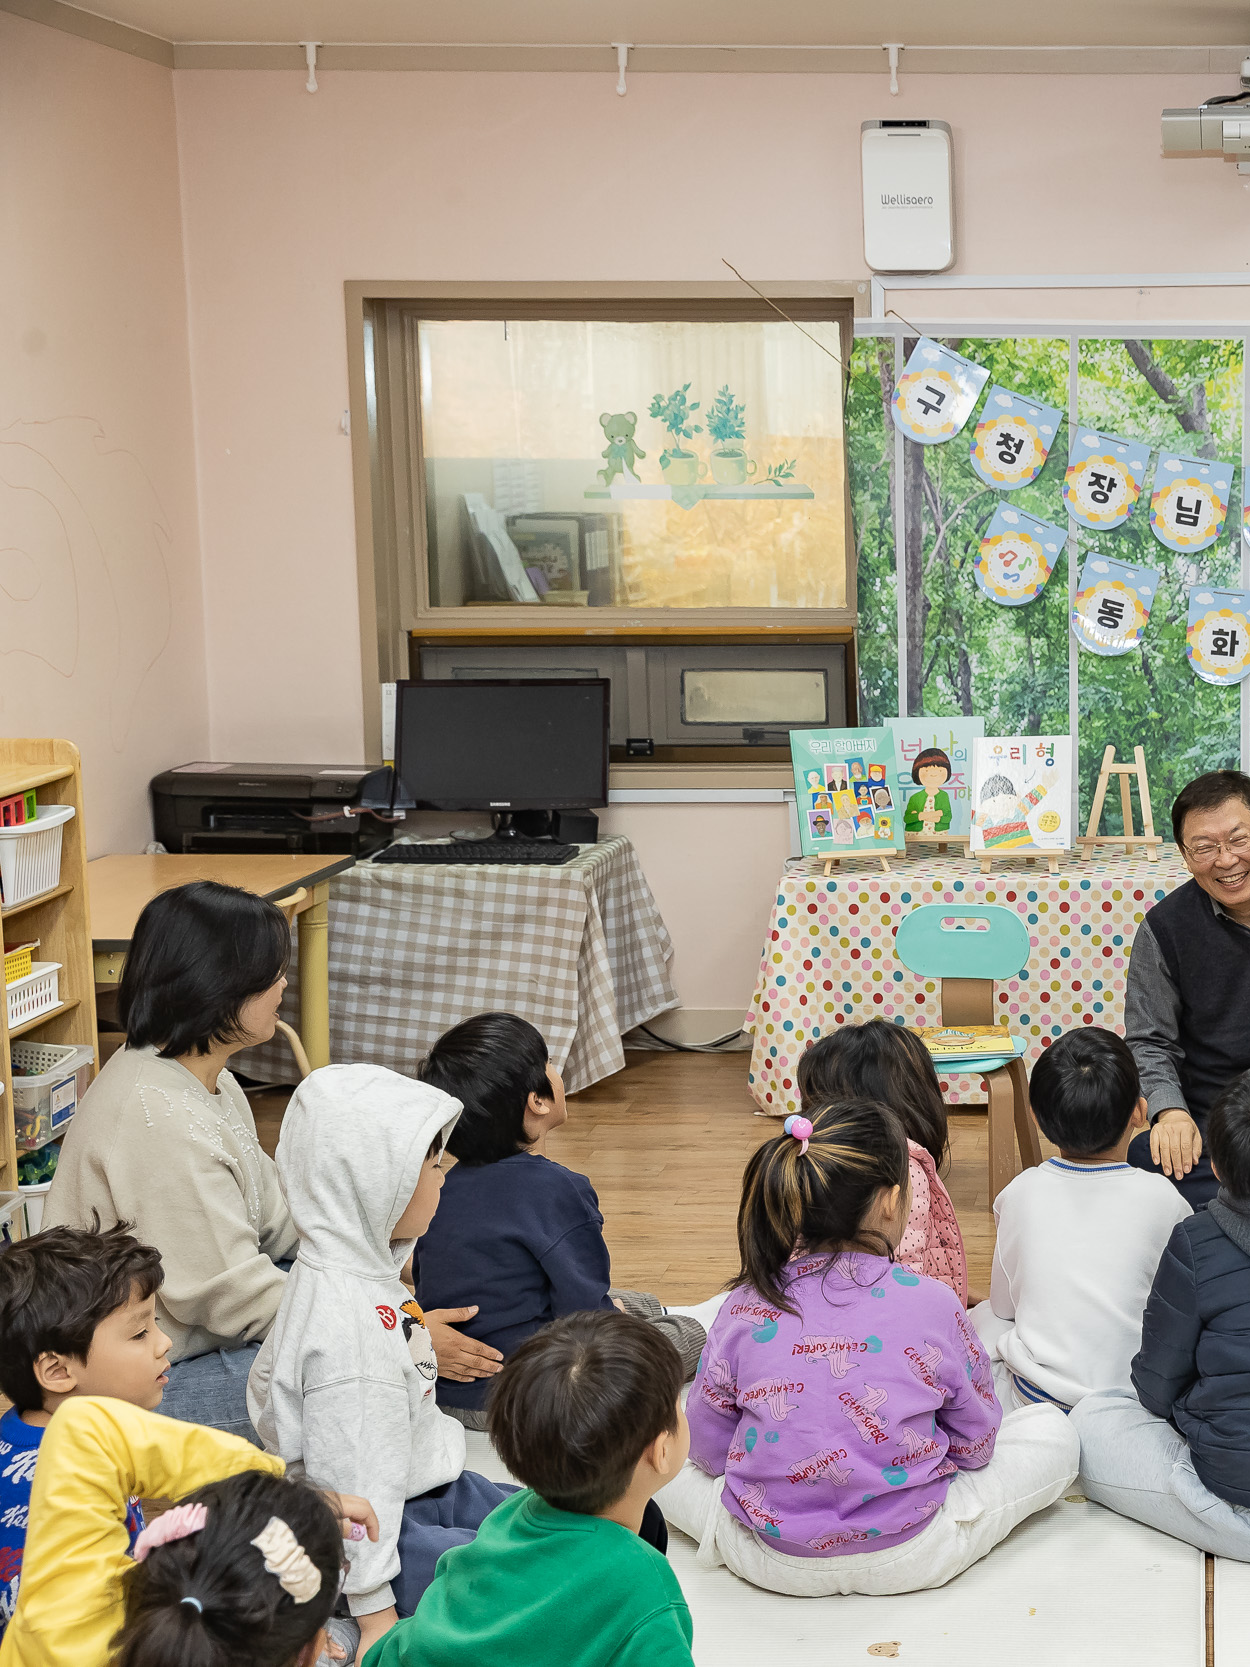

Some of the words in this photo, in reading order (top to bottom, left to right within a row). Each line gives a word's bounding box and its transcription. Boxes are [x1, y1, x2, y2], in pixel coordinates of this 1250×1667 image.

[811, 741, 831, 753] 우리
[835, 739, 876, 753] 할아버지
[988, 743, 1026, 766] 우리
[1035, 743, 1054, 766] 형
